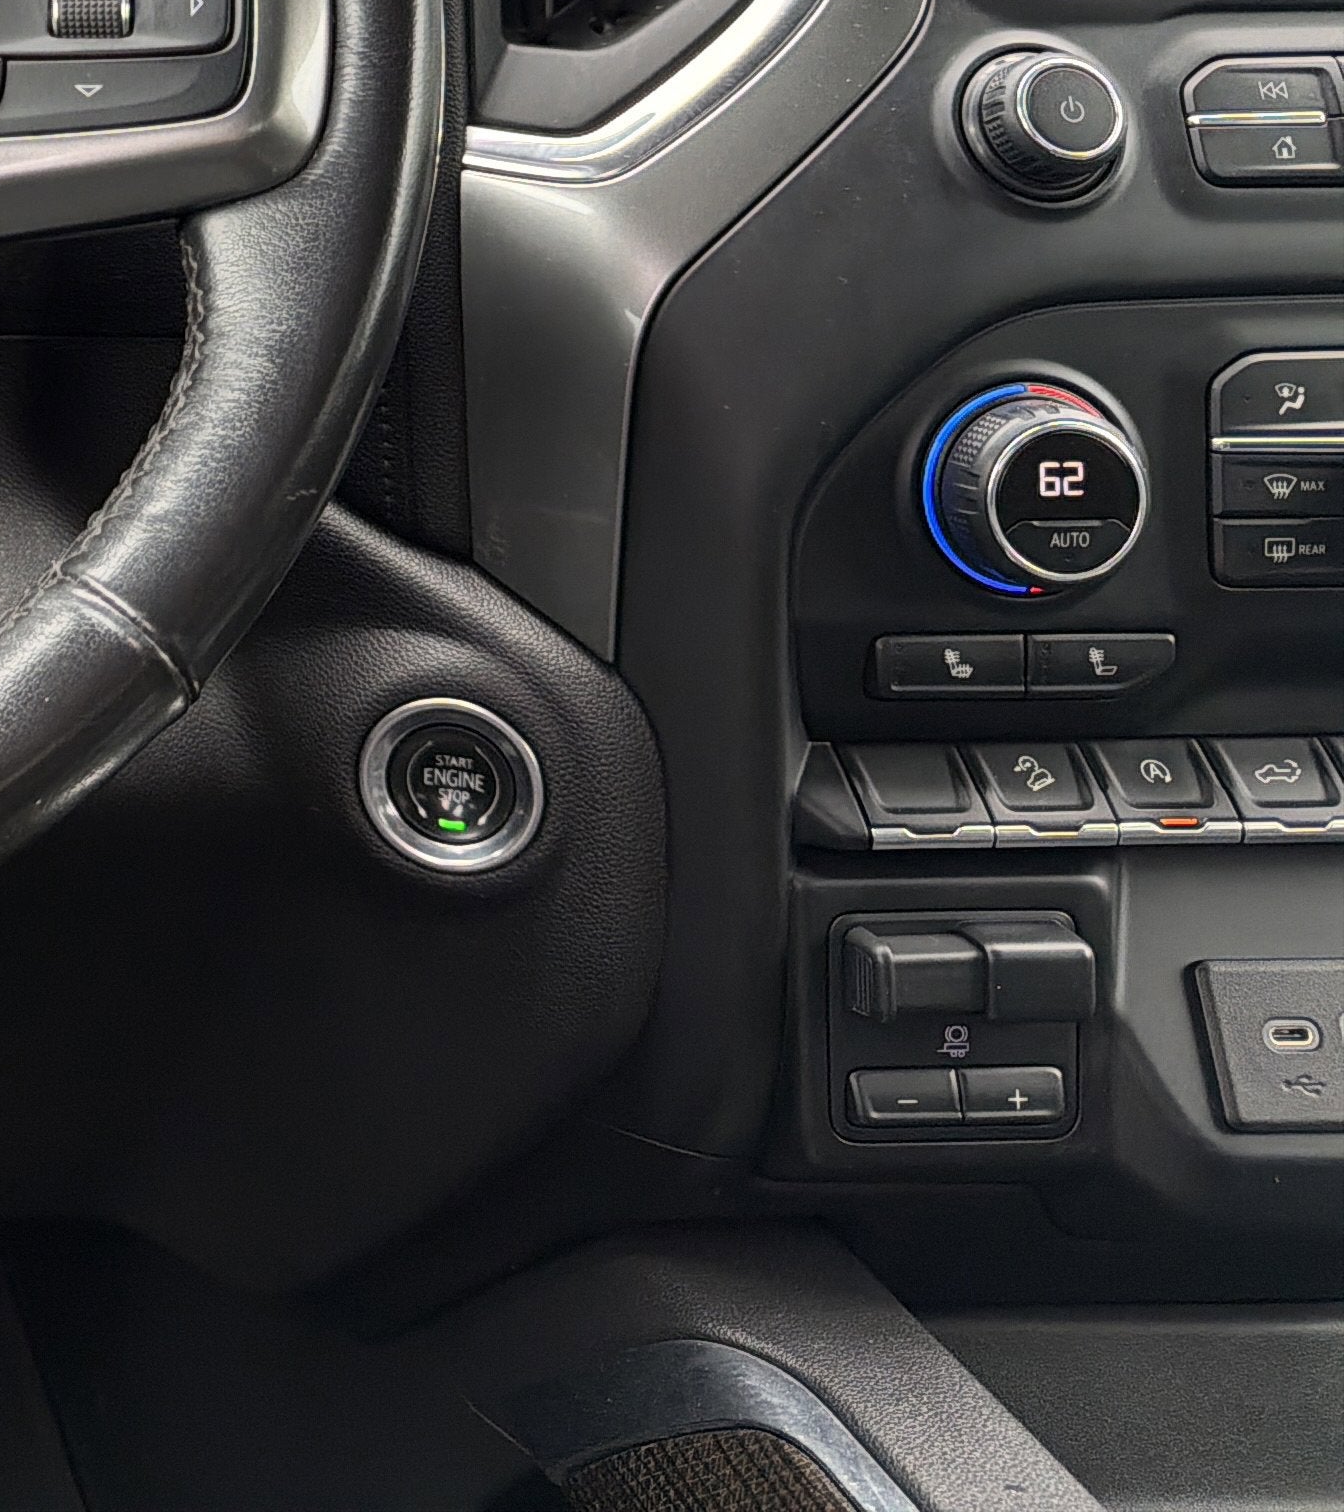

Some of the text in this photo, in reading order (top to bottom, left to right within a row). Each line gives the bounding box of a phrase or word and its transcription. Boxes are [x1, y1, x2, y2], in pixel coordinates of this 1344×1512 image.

[1038, 461, 1087, 498] 62
[1299, 480, 1326, 493] MAX
[1049, 531, 1091, 549] AUTO
[1298, 544, 1327, 557] REAR
[435, 754, 474, 769] START
[422, 766, 486, 793] ENGINE
[438, 787, 472, 804] STOP
